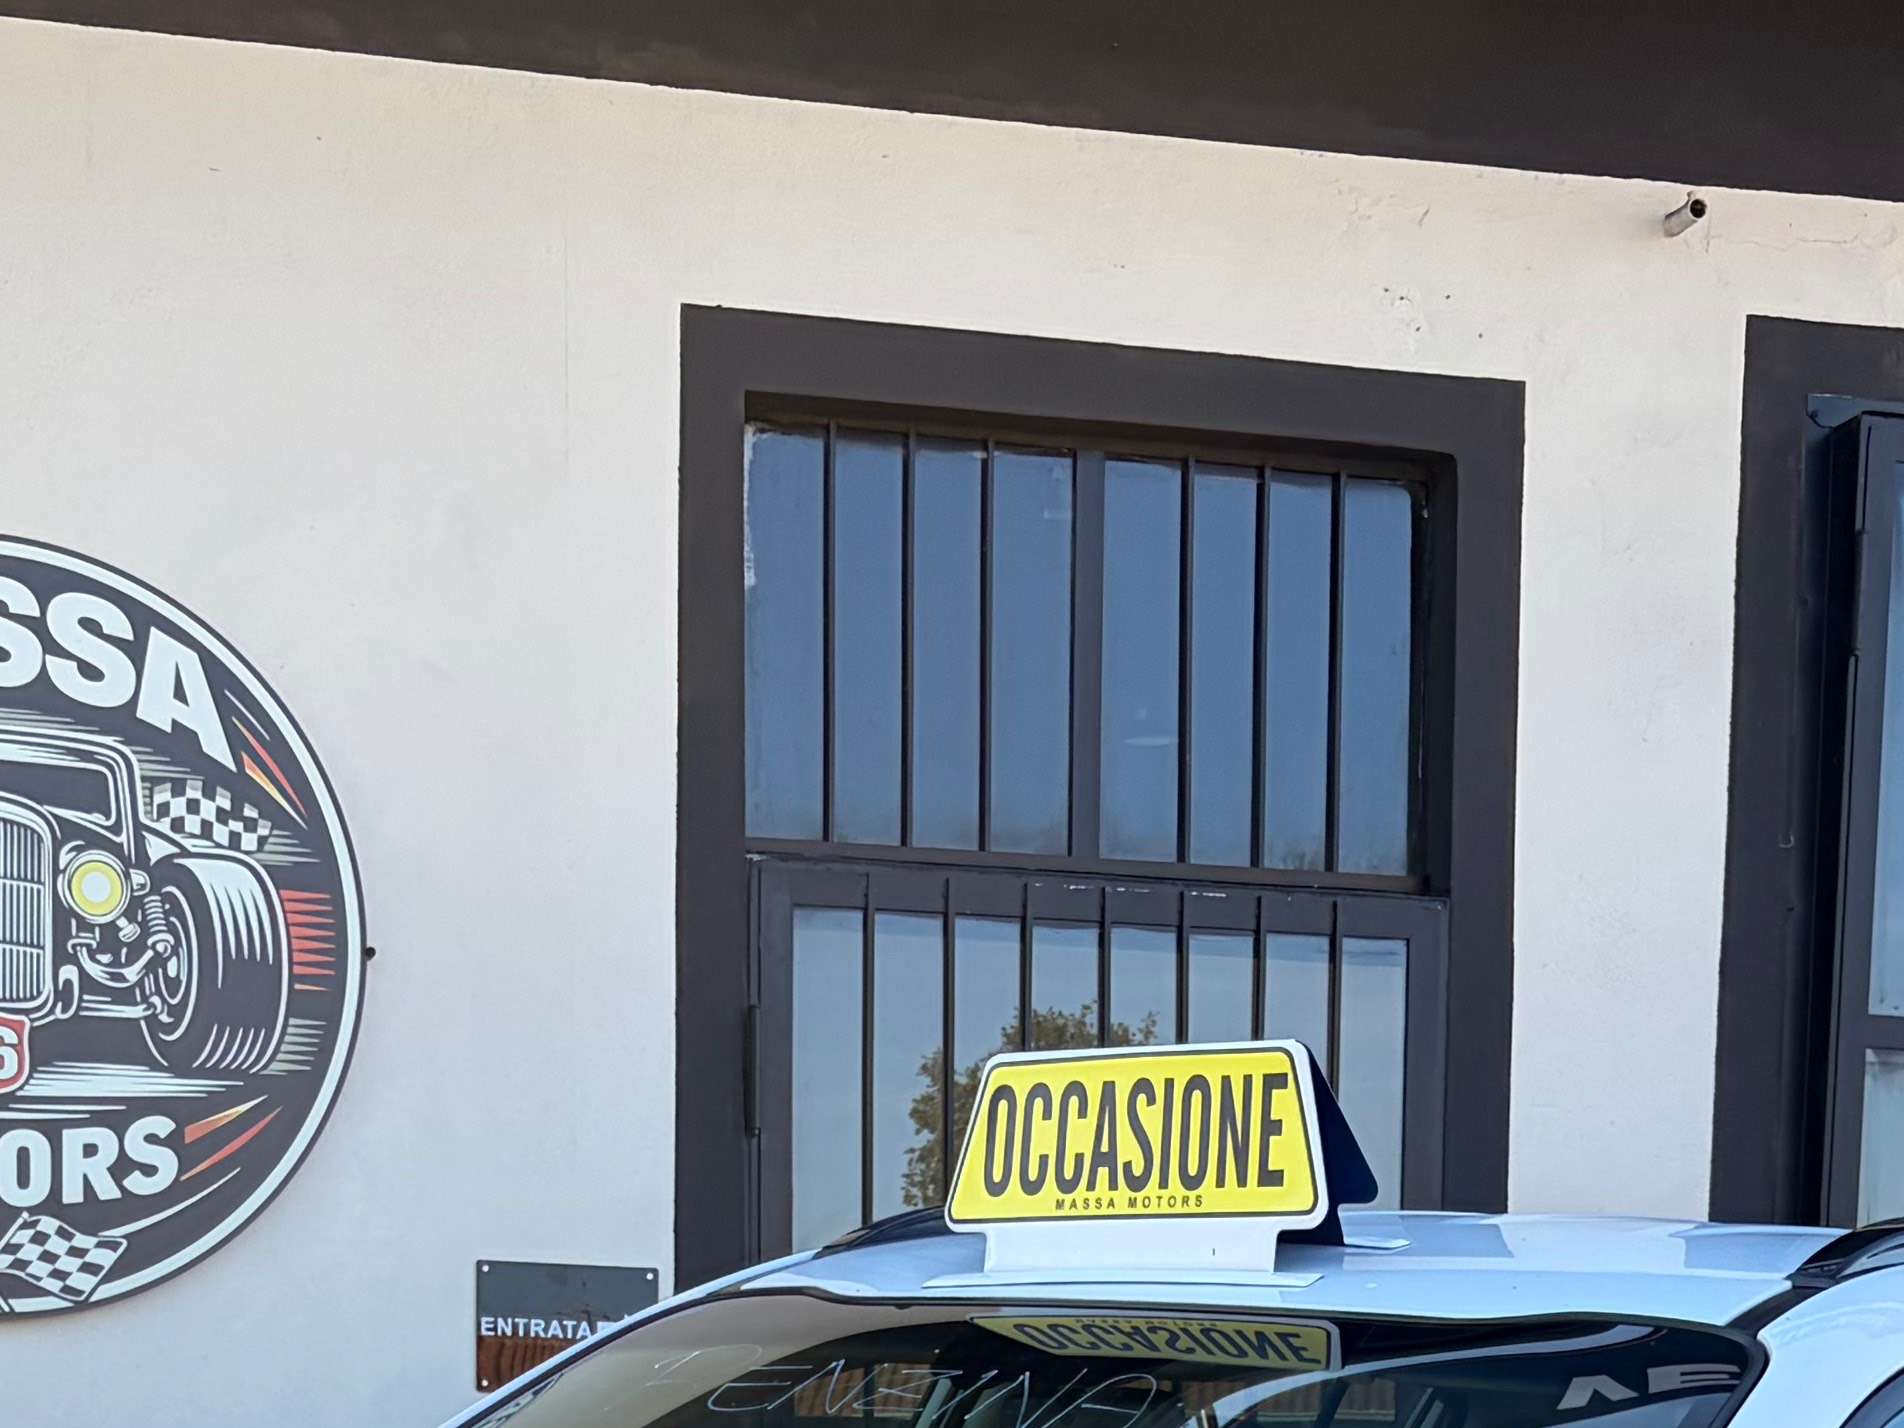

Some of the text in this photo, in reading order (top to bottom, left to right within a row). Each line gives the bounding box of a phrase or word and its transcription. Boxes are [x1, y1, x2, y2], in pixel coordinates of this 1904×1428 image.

[983, 1072, 1289, 1198] OCCASIONE
[1055, 1194, 1203, 1210] MASSA MOTORS
[480, 1316, 592, 1340] ENTRATA
